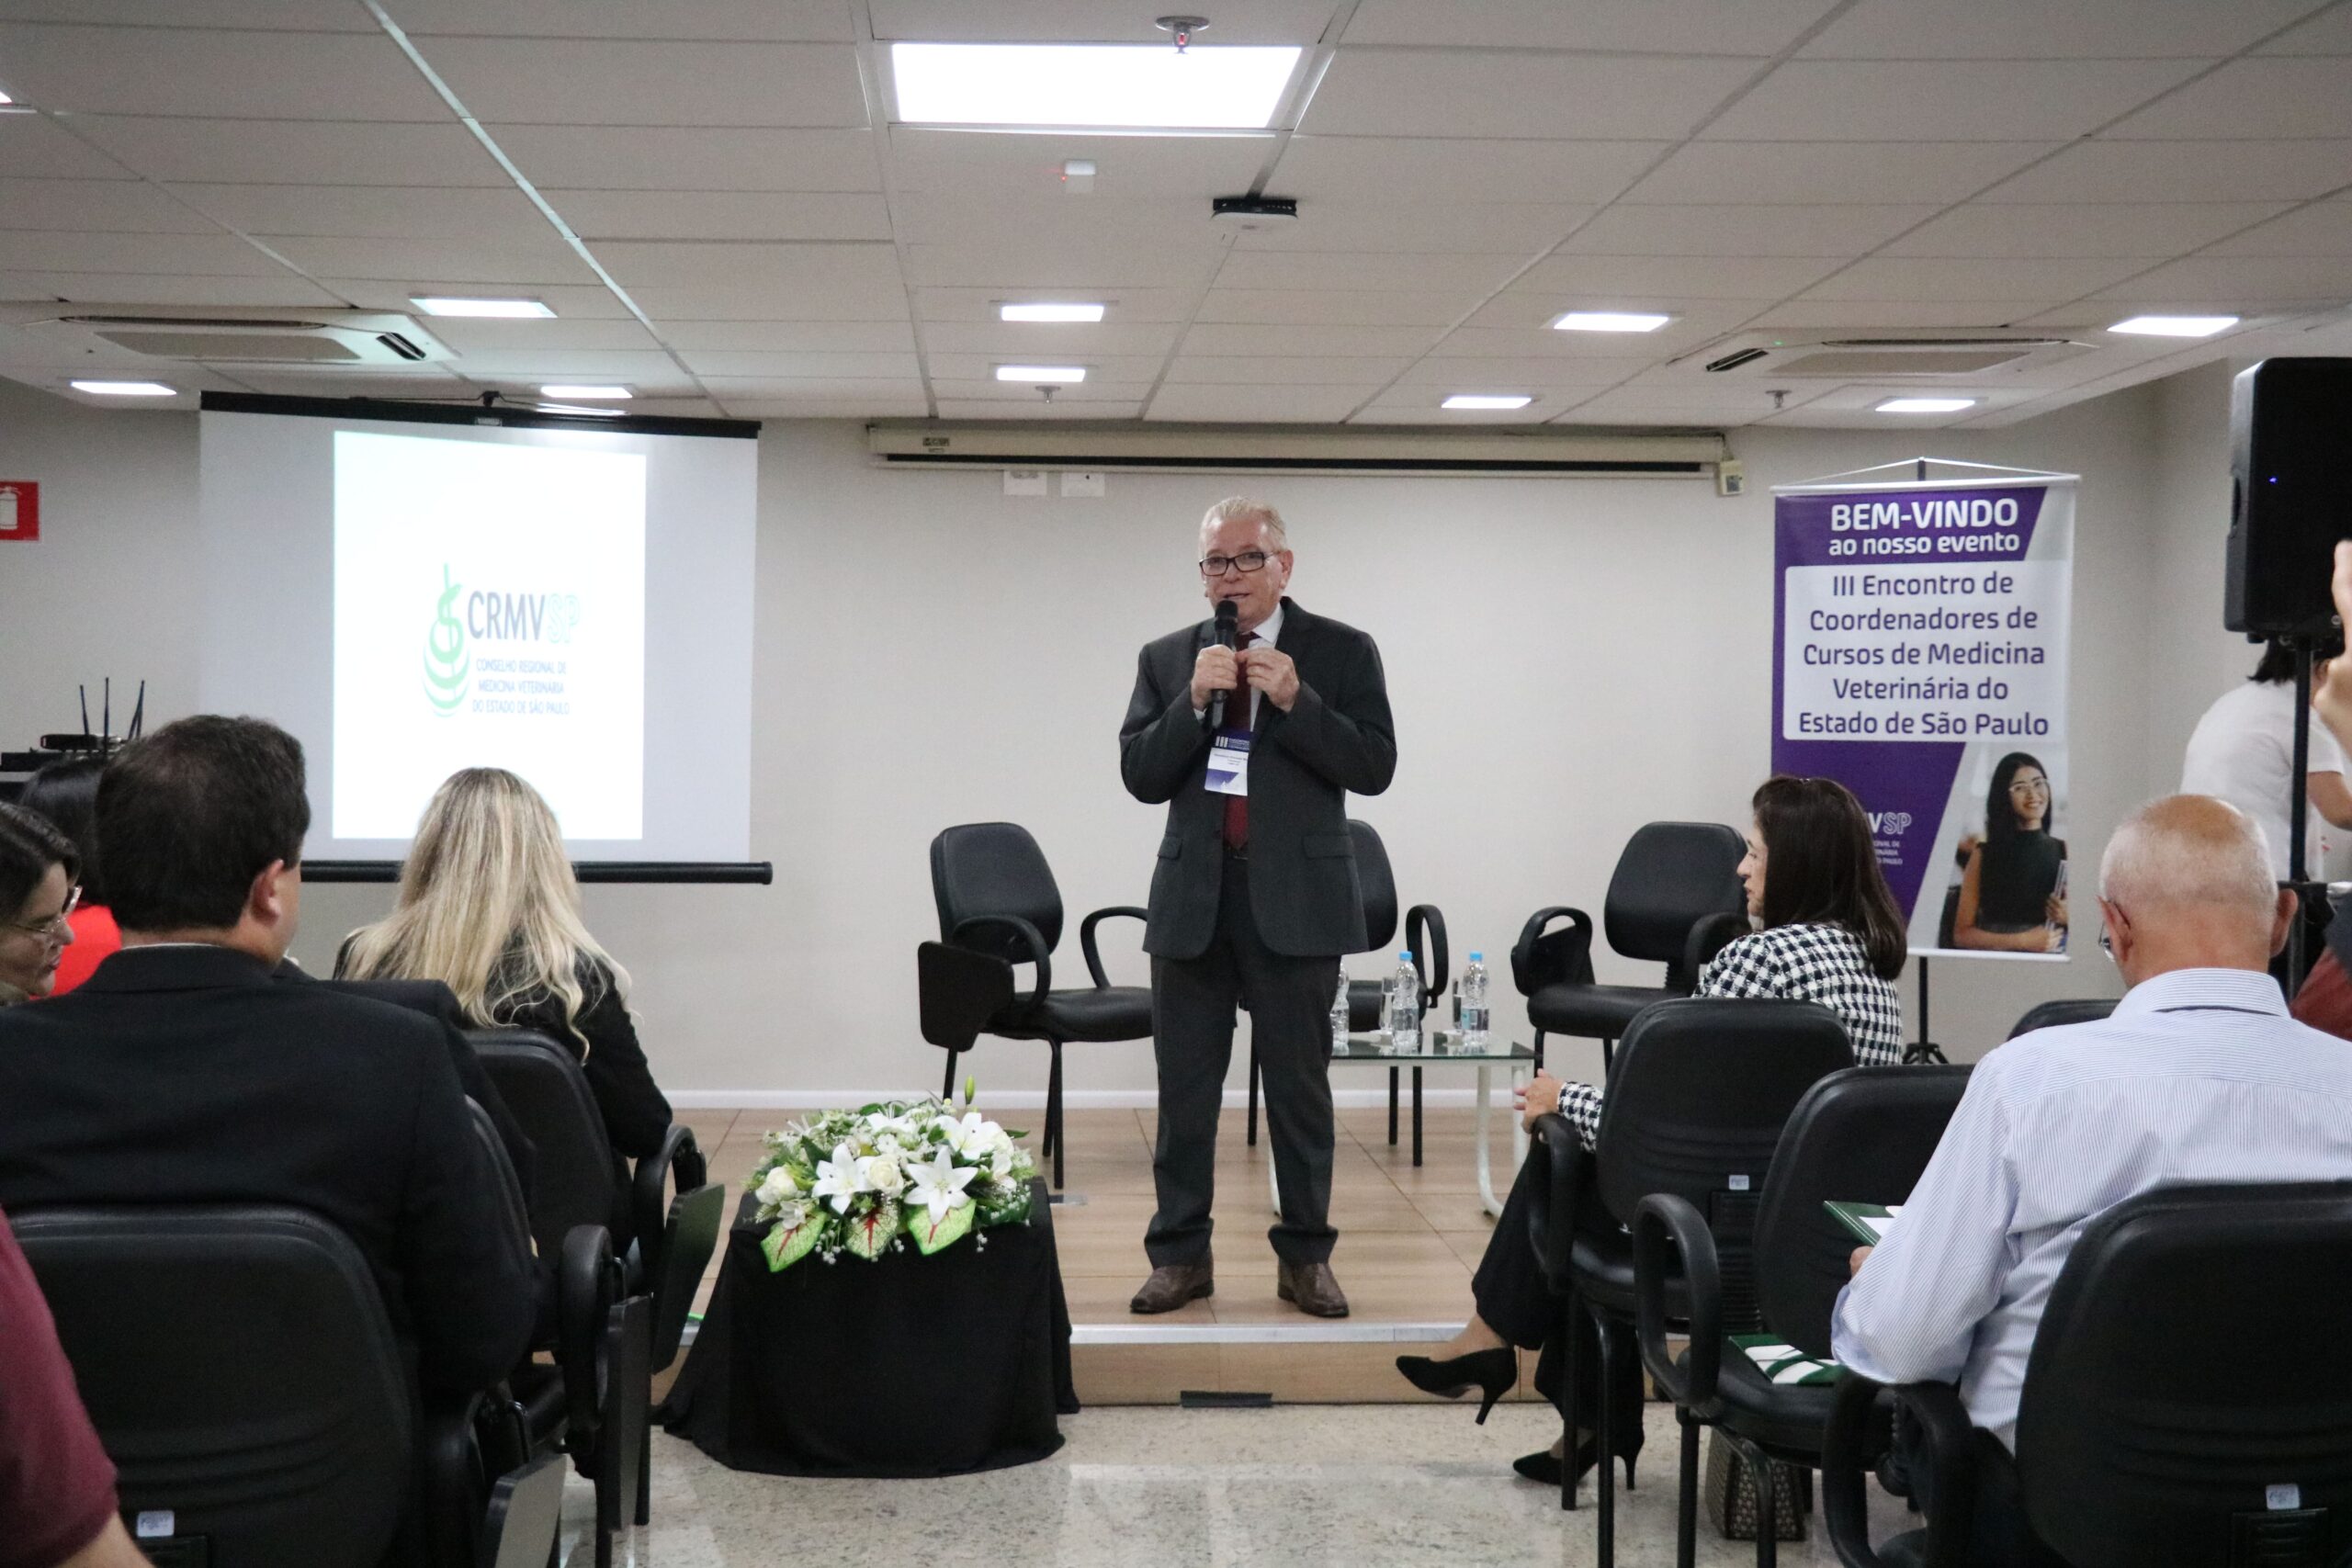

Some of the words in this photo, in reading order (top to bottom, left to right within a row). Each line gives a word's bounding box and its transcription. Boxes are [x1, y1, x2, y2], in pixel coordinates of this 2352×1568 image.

[1830, 498, 2019, 531] BEM-VINDO
[1828, 538, 1857, 556] ao
[1862, 536, 1931, 555] nosso
[1937, 532, 2020, 553] evento
[1833, 575, 1855, 596] III
[1863, 574, 1975, 595] Encontro
[1984, 570, 2014, 594] de
[1810, 606, 1999, 631] Coordenadores
[2007, 605, 2038, 629] de
[1804, 644, 1884, 666] Cursos
[1892, 642, 1921, 665] de
[1928, 641, 2045, 665] Medicina
[476, 658, 516, 672] CONSELHO
[519, 660, 555, 675] REGIONAL
[558, 660, 568, 675] DE
[478, 679, 514, 693] MEDICINA
[1833, 676, 1969, 700] Veterinária
[1977, 676, 2009, 700] do
[472, 699, 484, 713] DO
[486, 699, 514, 713] ESTADO
[517, 699, 526, 714] DE
[546, 700, 571, 716] PAULO
[1799, 710, 1878, 734] Estado
[1885, 711, 1916, 734] de
[1921, 711, 1967, 735] São
[1975, 711, 2050, 736] Paulo
[1867, 812, 1912, 835] VSP
